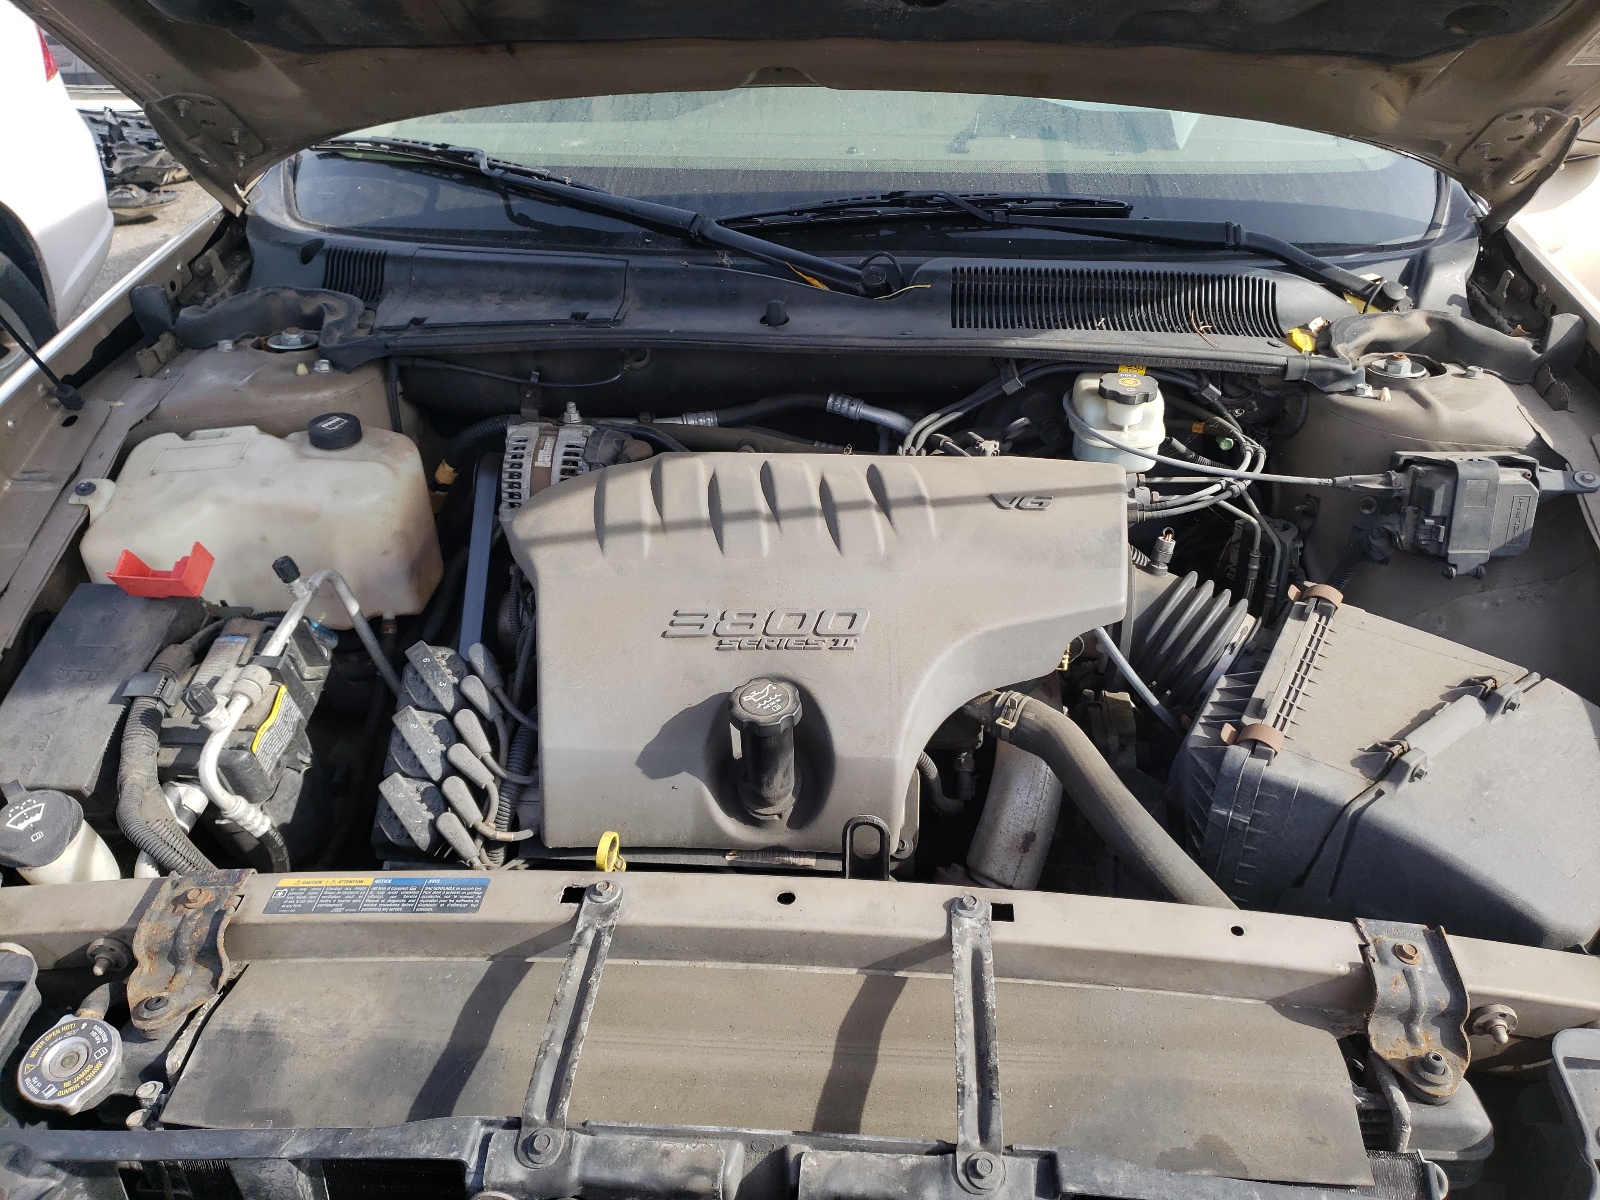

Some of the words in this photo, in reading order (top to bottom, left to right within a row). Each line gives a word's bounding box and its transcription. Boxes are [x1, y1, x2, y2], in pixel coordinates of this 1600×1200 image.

[988, 493, 1053, 511] V6
[661, 608, 870, 639] 3800
[714, 637, 826, 651] SERIES
[829, 637, 859, 651] II
[29, 1040, 45, 1058] NEVER
[45, 1028, 61, 1041] OPEN
[61, 1023, 76, 1032] HOT!
[63, 1079, 72, 1088] NE
[73, 1064, 94, 1084] JAMAIS
[57, 1084, 80, 1097] OUVRIR
